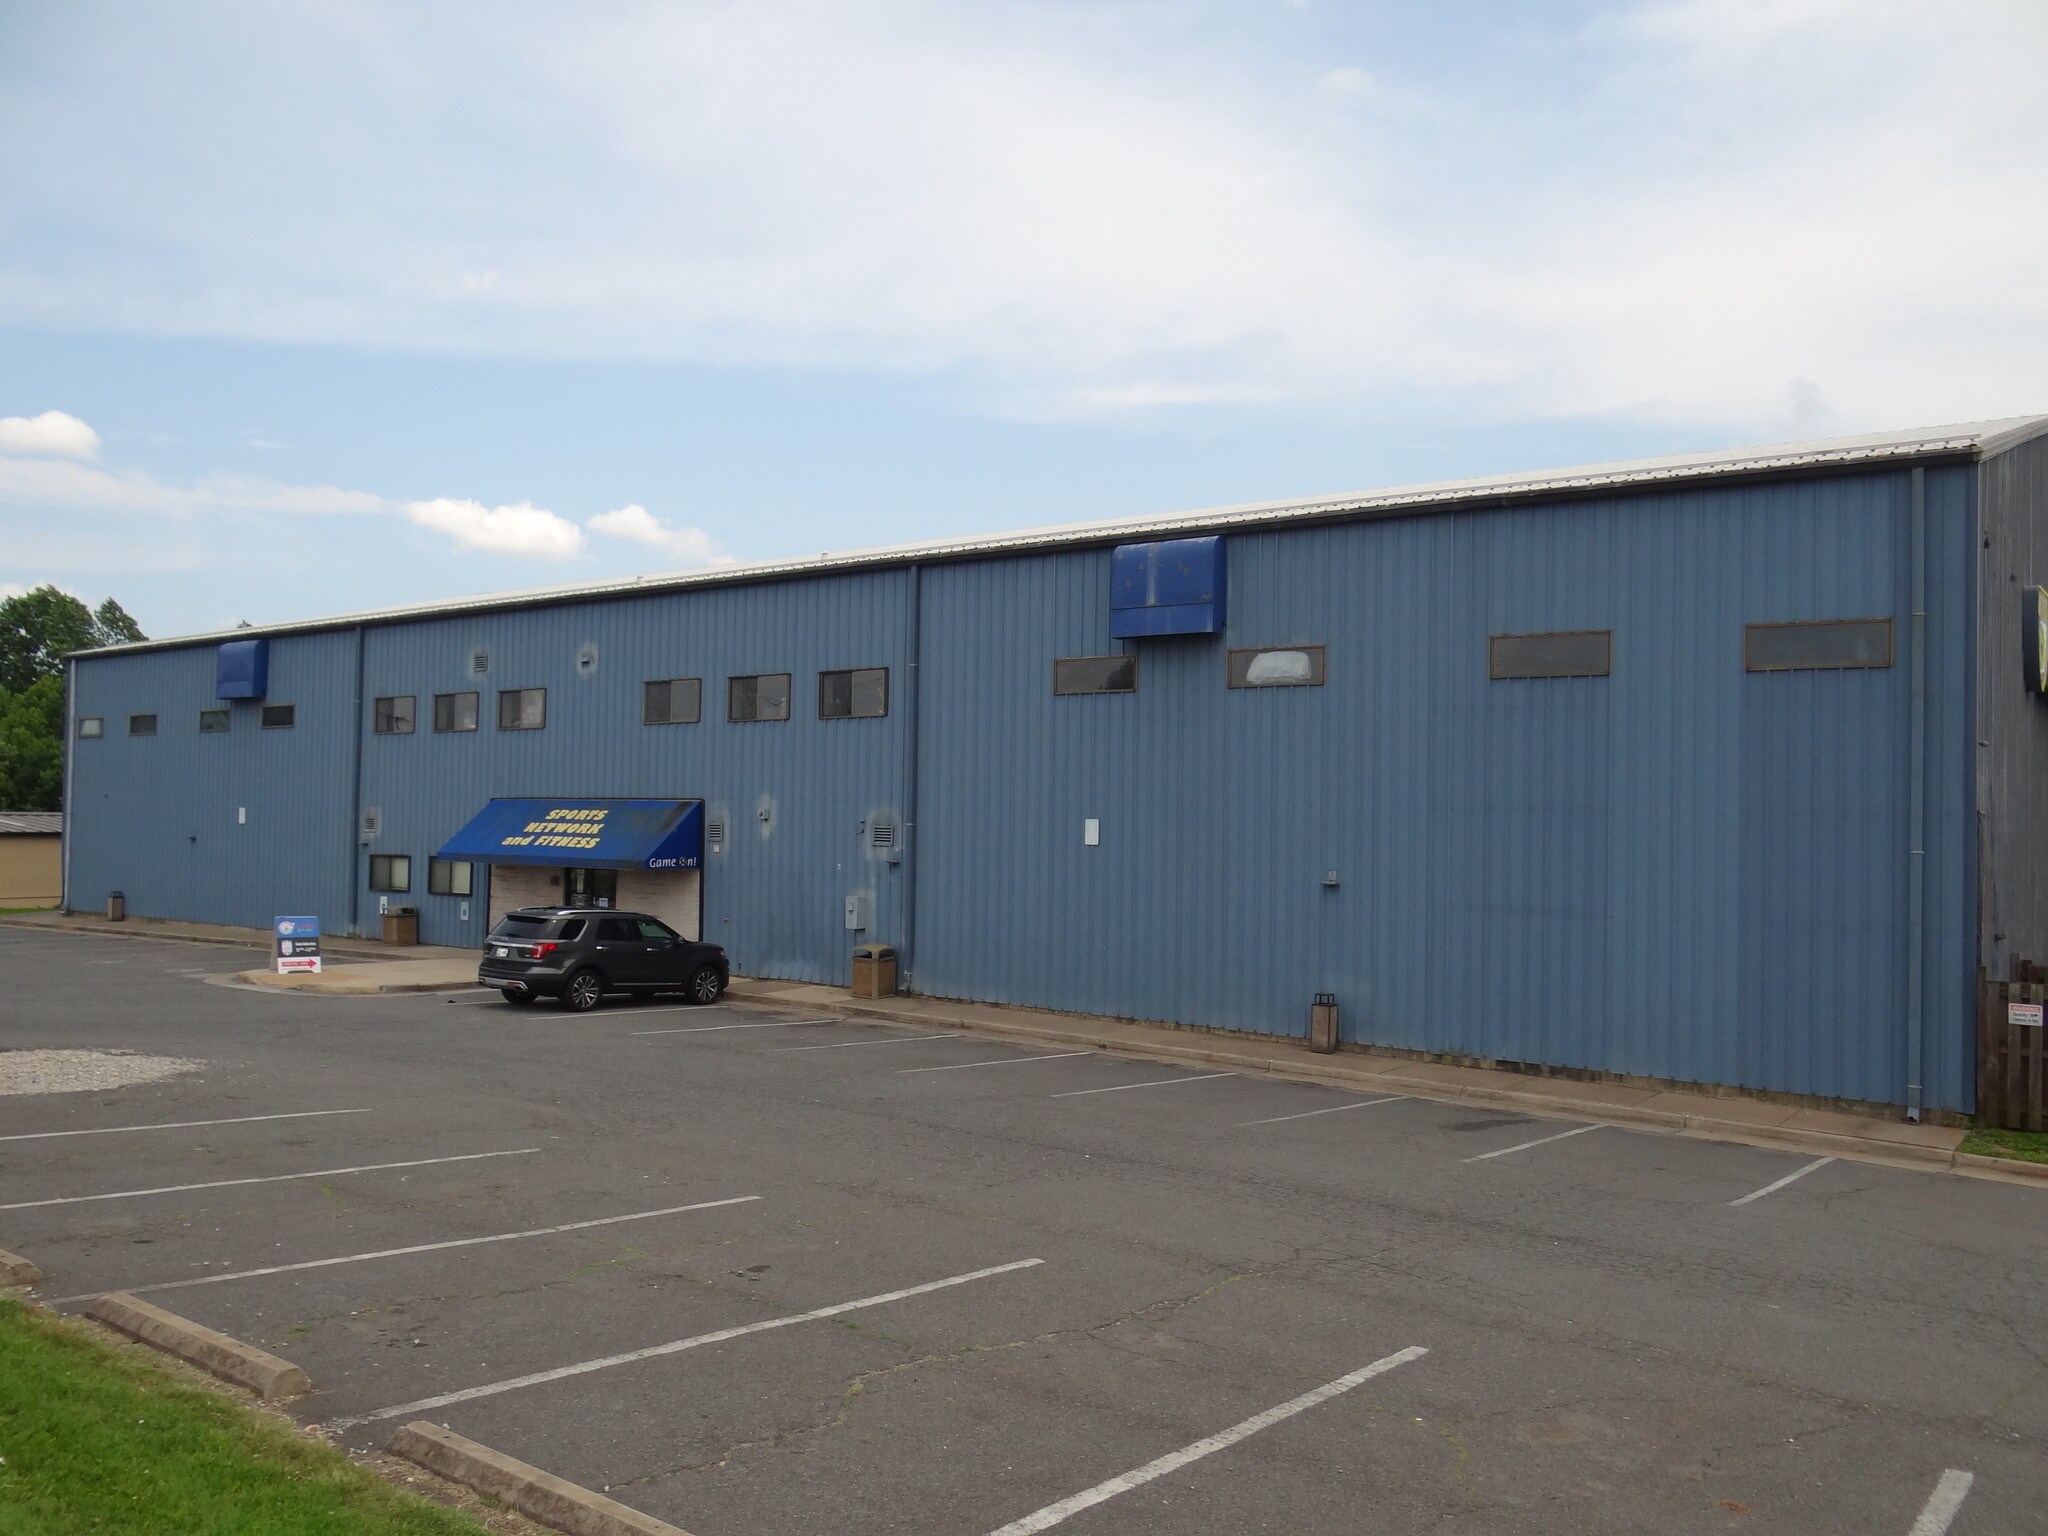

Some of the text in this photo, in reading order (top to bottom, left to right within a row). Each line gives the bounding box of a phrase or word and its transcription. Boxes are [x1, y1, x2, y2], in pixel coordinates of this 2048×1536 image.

[545, 809, 609, 820] SPORTS
[523, 822, 605, 834] NETWORK
[501, 835, 601, 849] and FITNESS
[649, 857, 677, 868] Game
